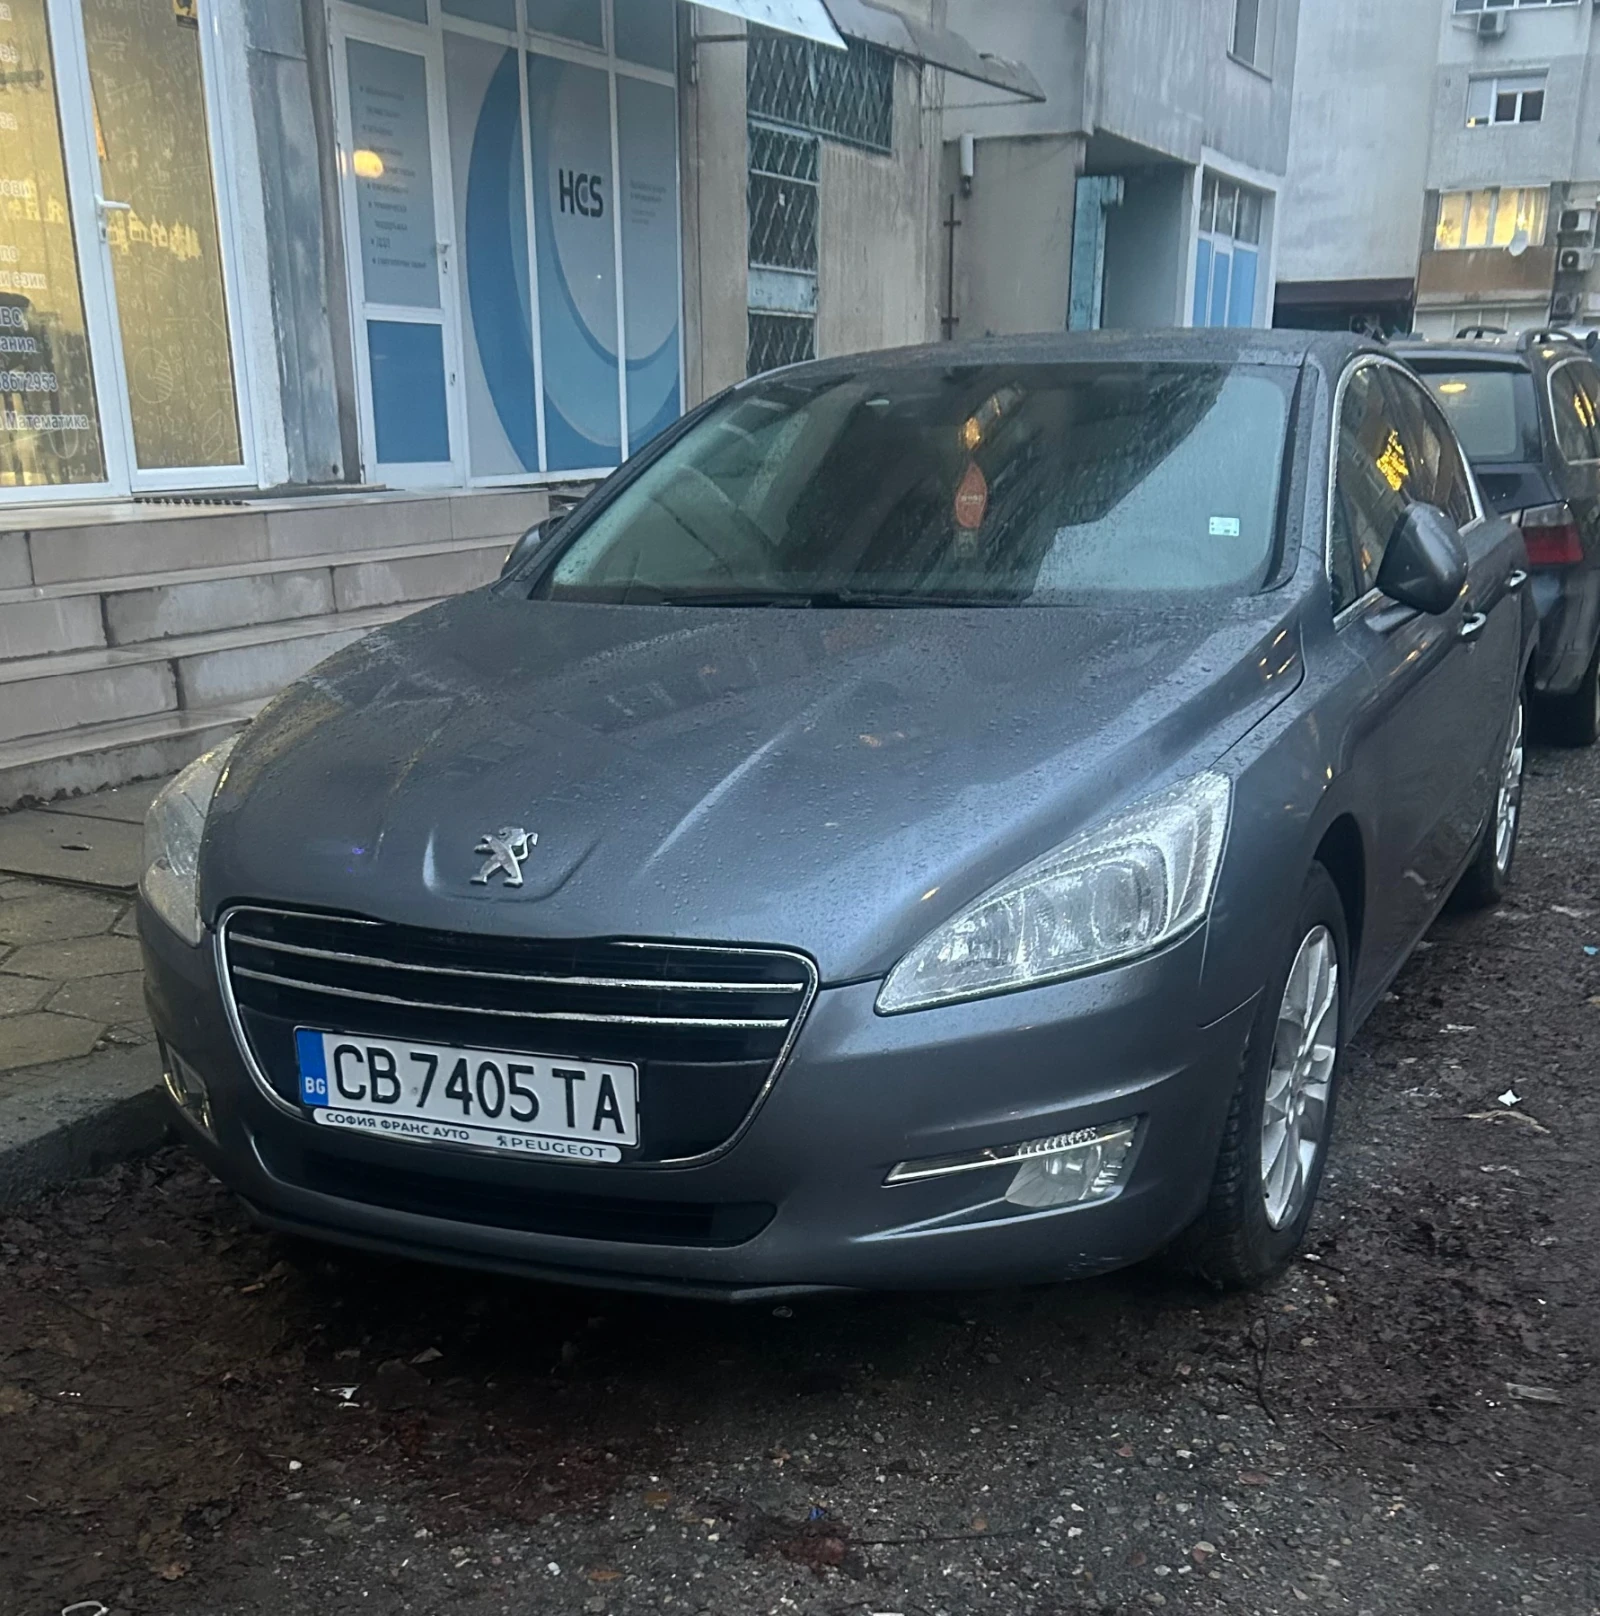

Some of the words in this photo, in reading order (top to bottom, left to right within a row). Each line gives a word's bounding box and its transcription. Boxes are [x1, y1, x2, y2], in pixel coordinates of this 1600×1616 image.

[558, 168, 604, 218] HCS
[0, 373, 57, 391] 8672953
[5, 411, 88, 430] Математика
[305, 1077, 326, 1095] BG
[410, 1052, 539, 1122] 7405
[325, 1112, 376, 1128] СОФИЯ
[381, 1118, 430, 1136] ФРАНС
[432, 1125, 470, 1141] АУТО
[511, 1137, 606, 1159] PEUGEOT
